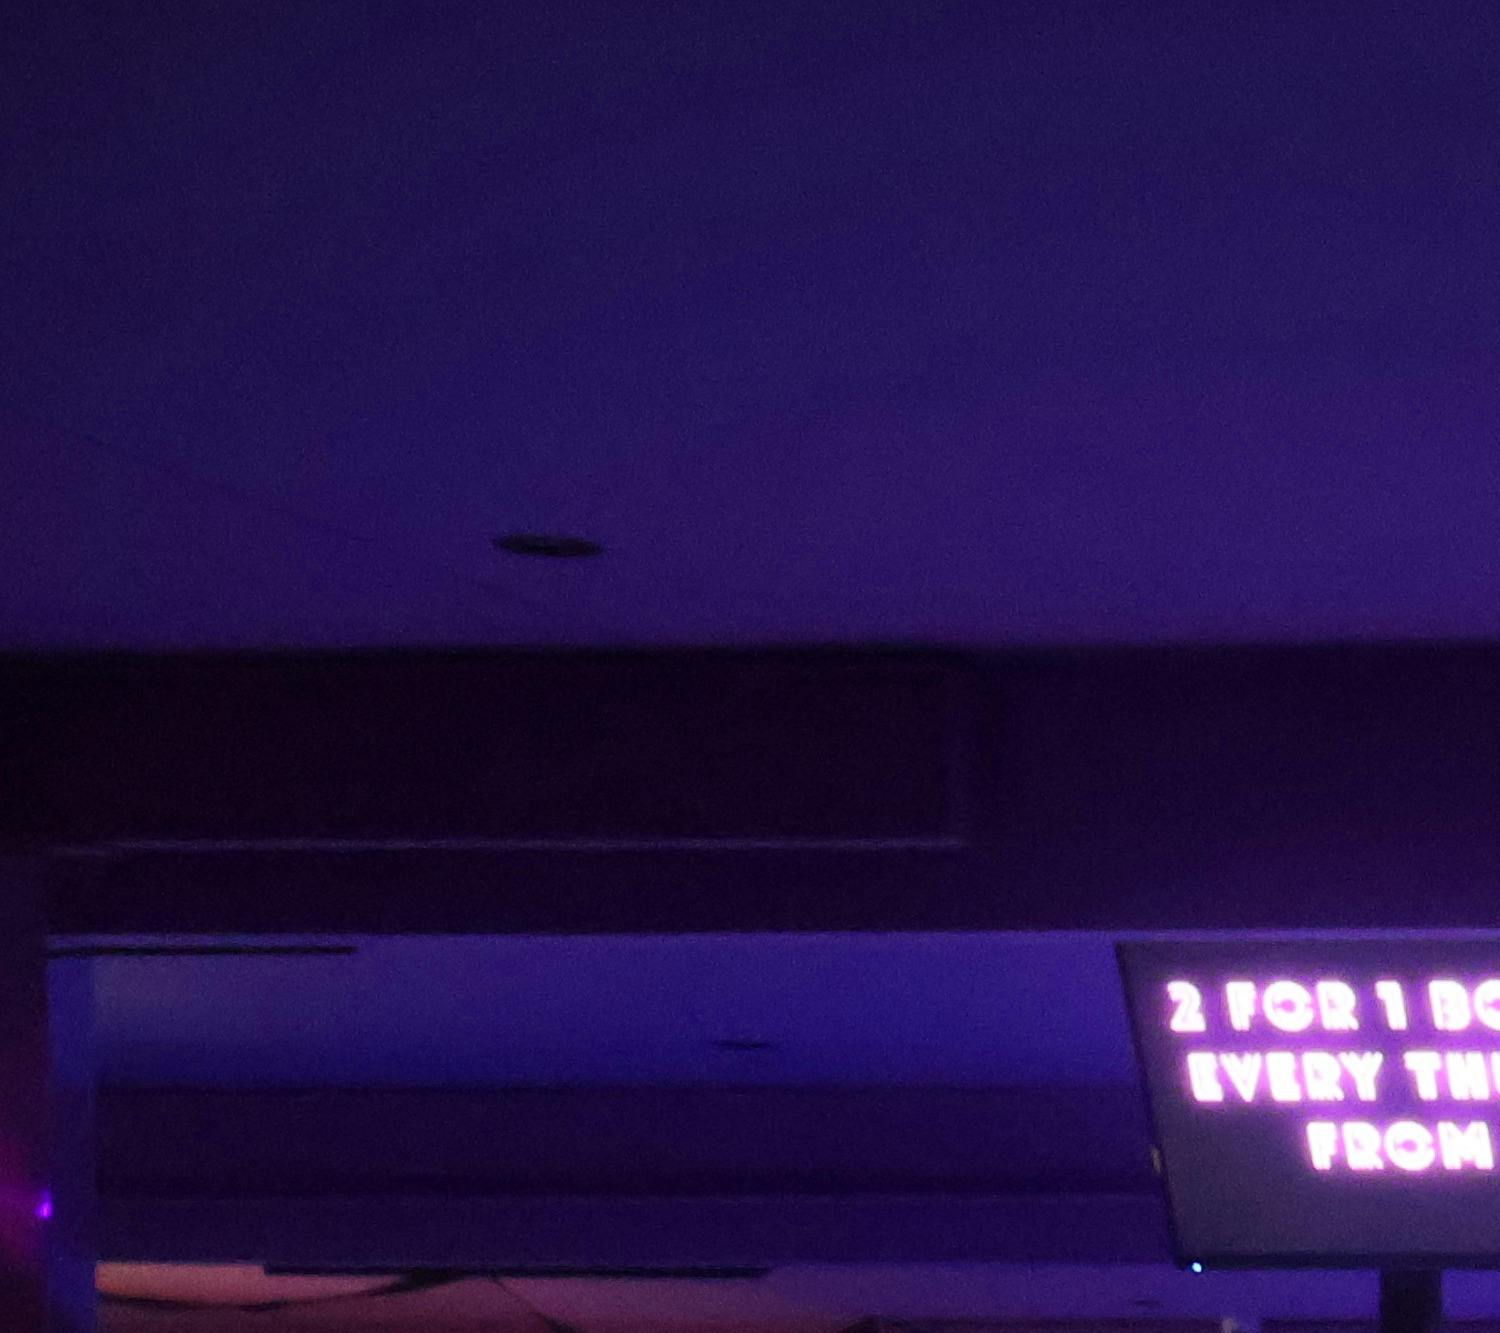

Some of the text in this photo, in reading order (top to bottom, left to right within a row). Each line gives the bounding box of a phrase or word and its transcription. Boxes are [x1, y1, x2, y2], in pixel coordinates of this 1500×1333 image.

[1166, 980, 1207, 1032] 2
[1225, 979, 1359, 1031] FOR
[1375, 980, 1408, 1031] 1
[1186, 1050, 1384, 1103] EVERY
[1306, 1120, 1494, 1171] FROM
